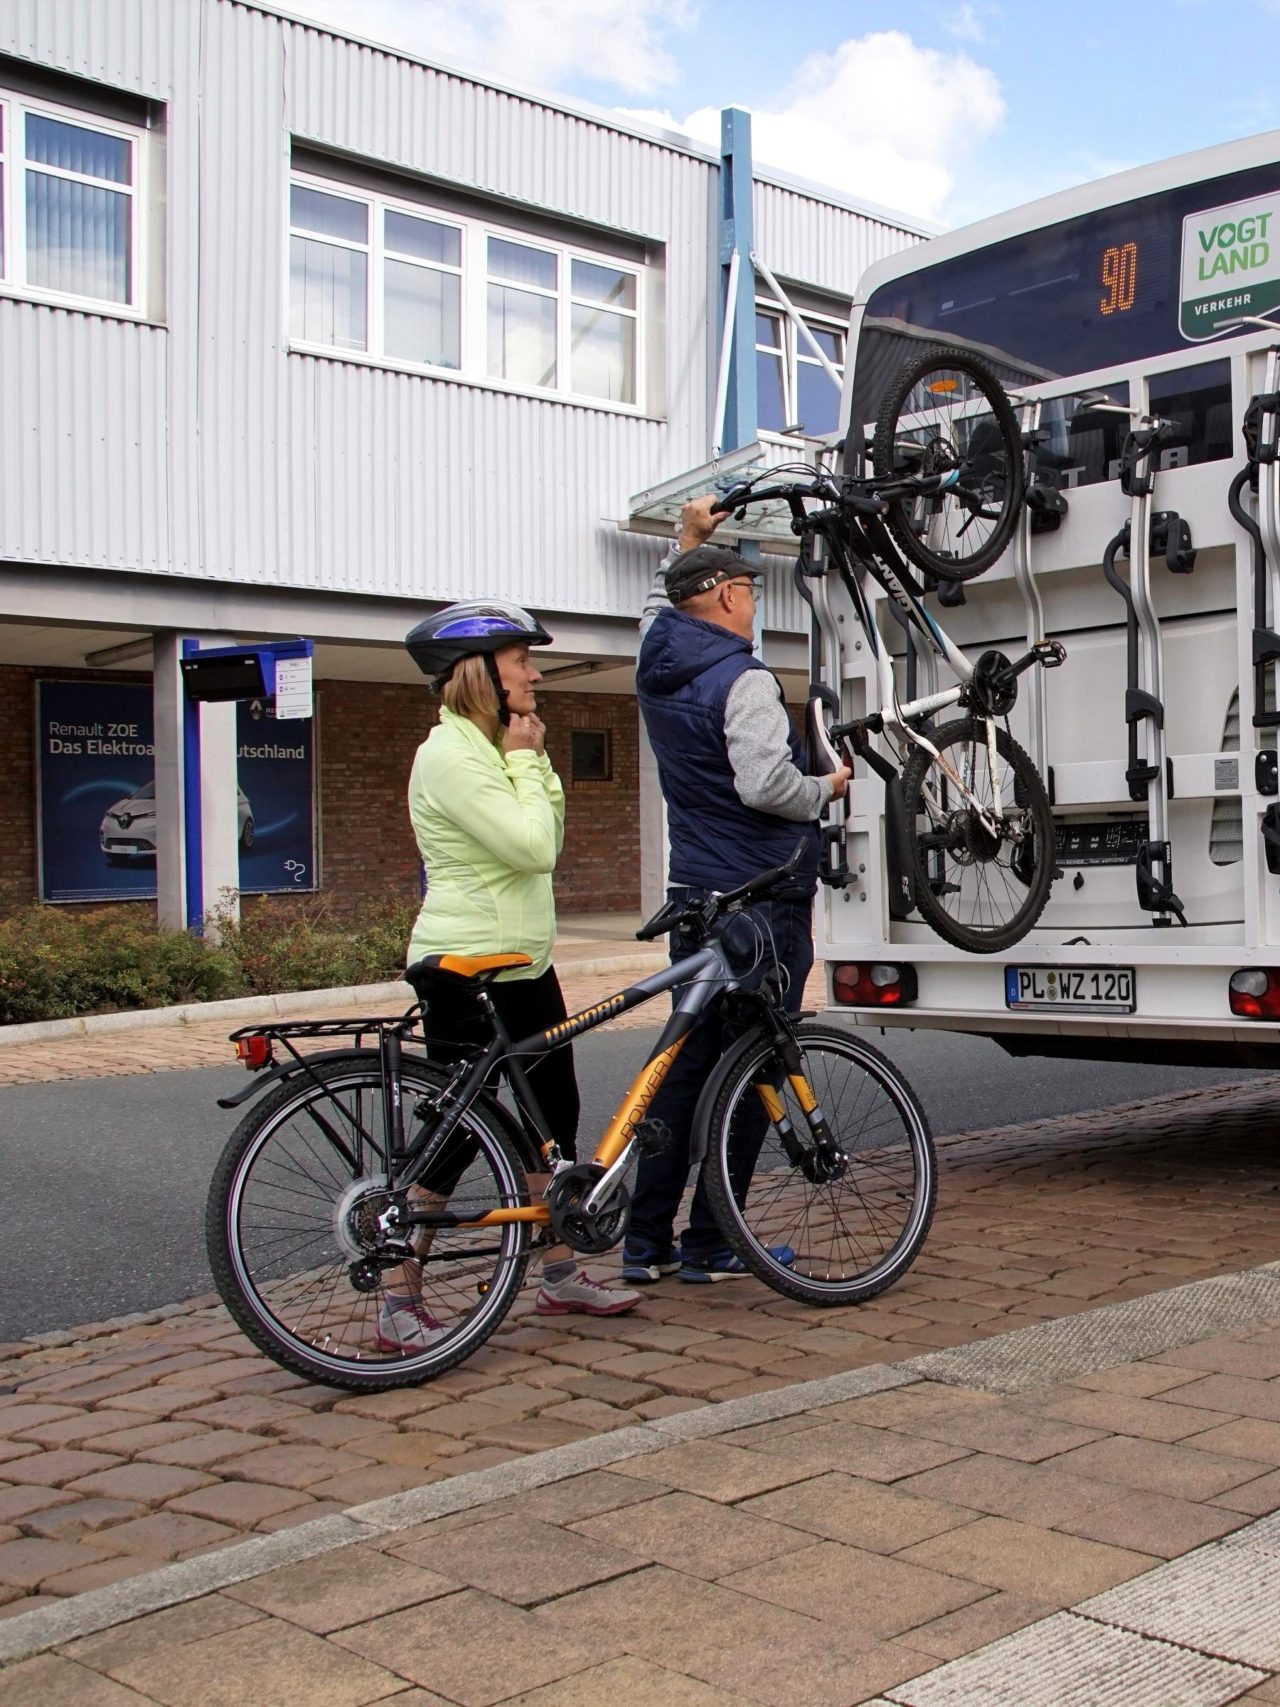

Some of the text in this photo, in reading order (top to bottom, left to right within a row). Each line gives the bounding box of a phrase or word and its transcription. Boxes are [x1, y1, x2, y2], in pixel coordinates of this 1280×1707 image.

[1198, 212, 1273, 253] VOGT
[1099, 242, 1137, 316] 90
[1198, 241, 1270, 281] LAND
[1194, 293, 1252, 316] VERKEHR
[872, 553, 916, 613] GIANT
[49, 721, 138, 738] Renault ZOE
[49, 738, 305, 760] Das Elektroa utschland
[1019, 971, 1045, 999] PL
[1059, 972, 1086, 1000] WZ
[1091, 973, 1131, 1001] 120
[545, 994, 625, 1045] WINORA
[620, 1059, 669, 1140] POWER
